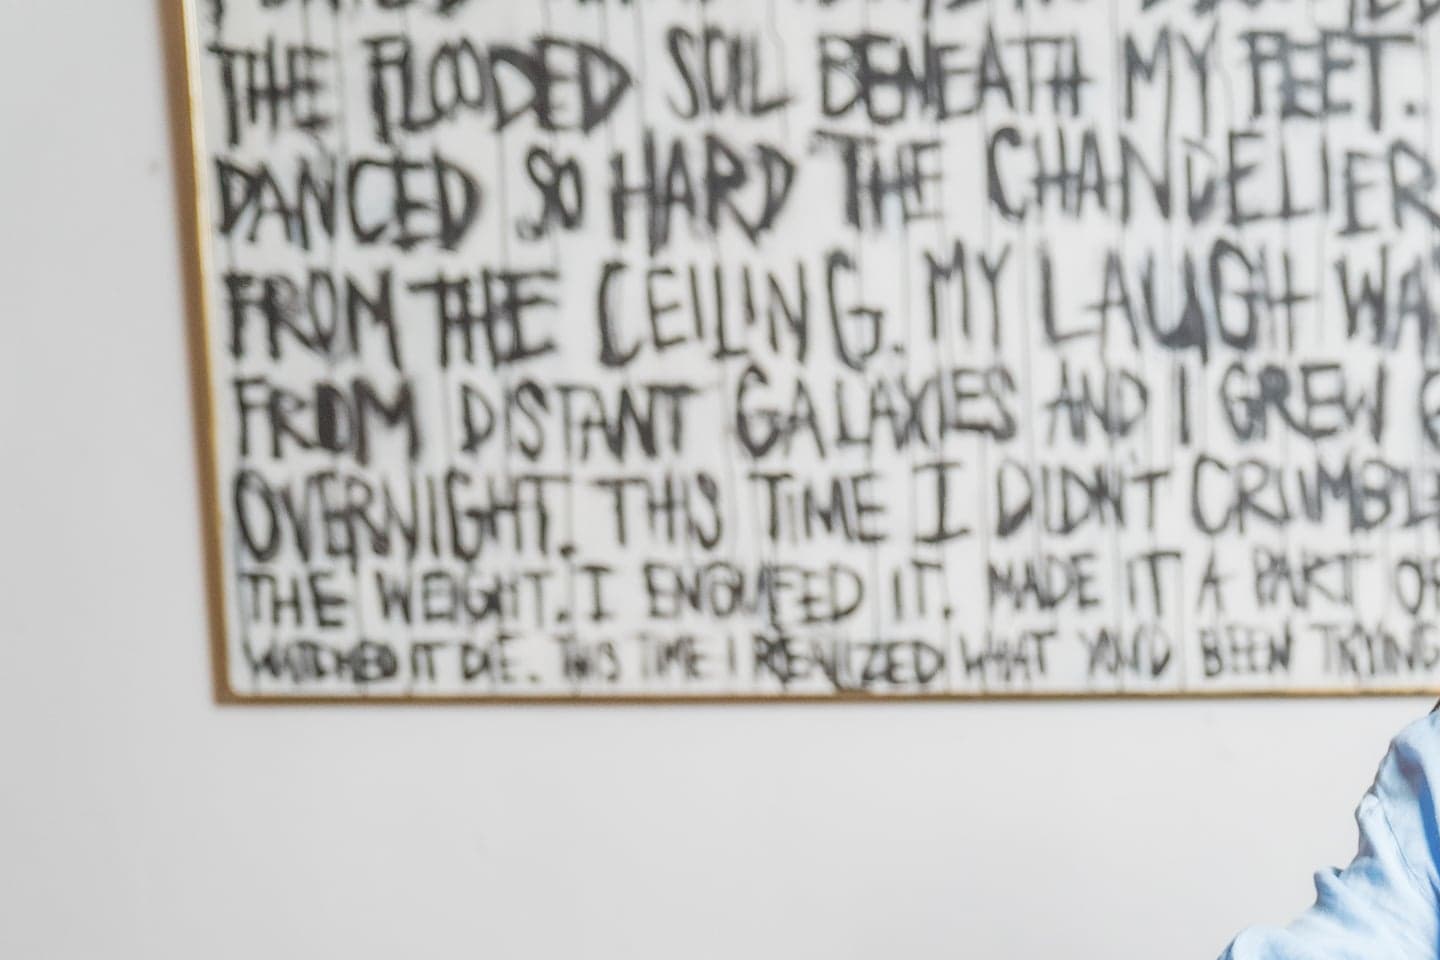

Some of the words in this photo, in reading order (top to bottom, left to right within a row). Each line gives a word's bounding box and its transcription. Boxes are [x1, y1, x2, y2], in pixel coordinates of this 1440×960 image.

[206, 34, 332, 147] THE
[362, 33, 636, 144] FLOODED
[667, 26, 793, 120] SOIL
[816, 24, 1092, 124] BENEATH
[1122, 24, 1219, 145] MY
[215, 150, 484, 250] DANCED
[515, 146, 585, 241] SO
[609, 128, 797, 257] HARD
[812, 128, 946, 232] THE
[222, 268, 405, 370] FROM
[406, 268, 562, 368] THE
[923, 237, 1011, 350] MY
[1040, 238, 1322, 363] LAUGH
[233, 377, 422, 465] FROM
[460, 380, 701, 462] DISTANT
[737, 364, 1018, 460] GALAXIES
[1047, 360, 1150, 444] AND
[1178, 366, 1193, 447] I
[1219, 361, 1386, 450] GREW
[597, 473, 723, 550] THIS
[748, 472, 890, 545] TIME
[913, 460, 969, 545] I
[242, 570, 346, 627] THE
[579, 565, 613, 622] I
[987, 553, 1101, 609] MADE
[1125, 551, 1182, 616] IT
[1198, 548, 1236, 612] A
[1254, 549, 1373, 611] PART
[410, 641, 451, 681] IT
[556, 633, 622, 684] THIS
[637, 632, 704, 676] TIME
[727, 636, 736, 676] I
[959, 629, 1058, 683] WHAT
[1200, 622, 1293, 678] BEEN
